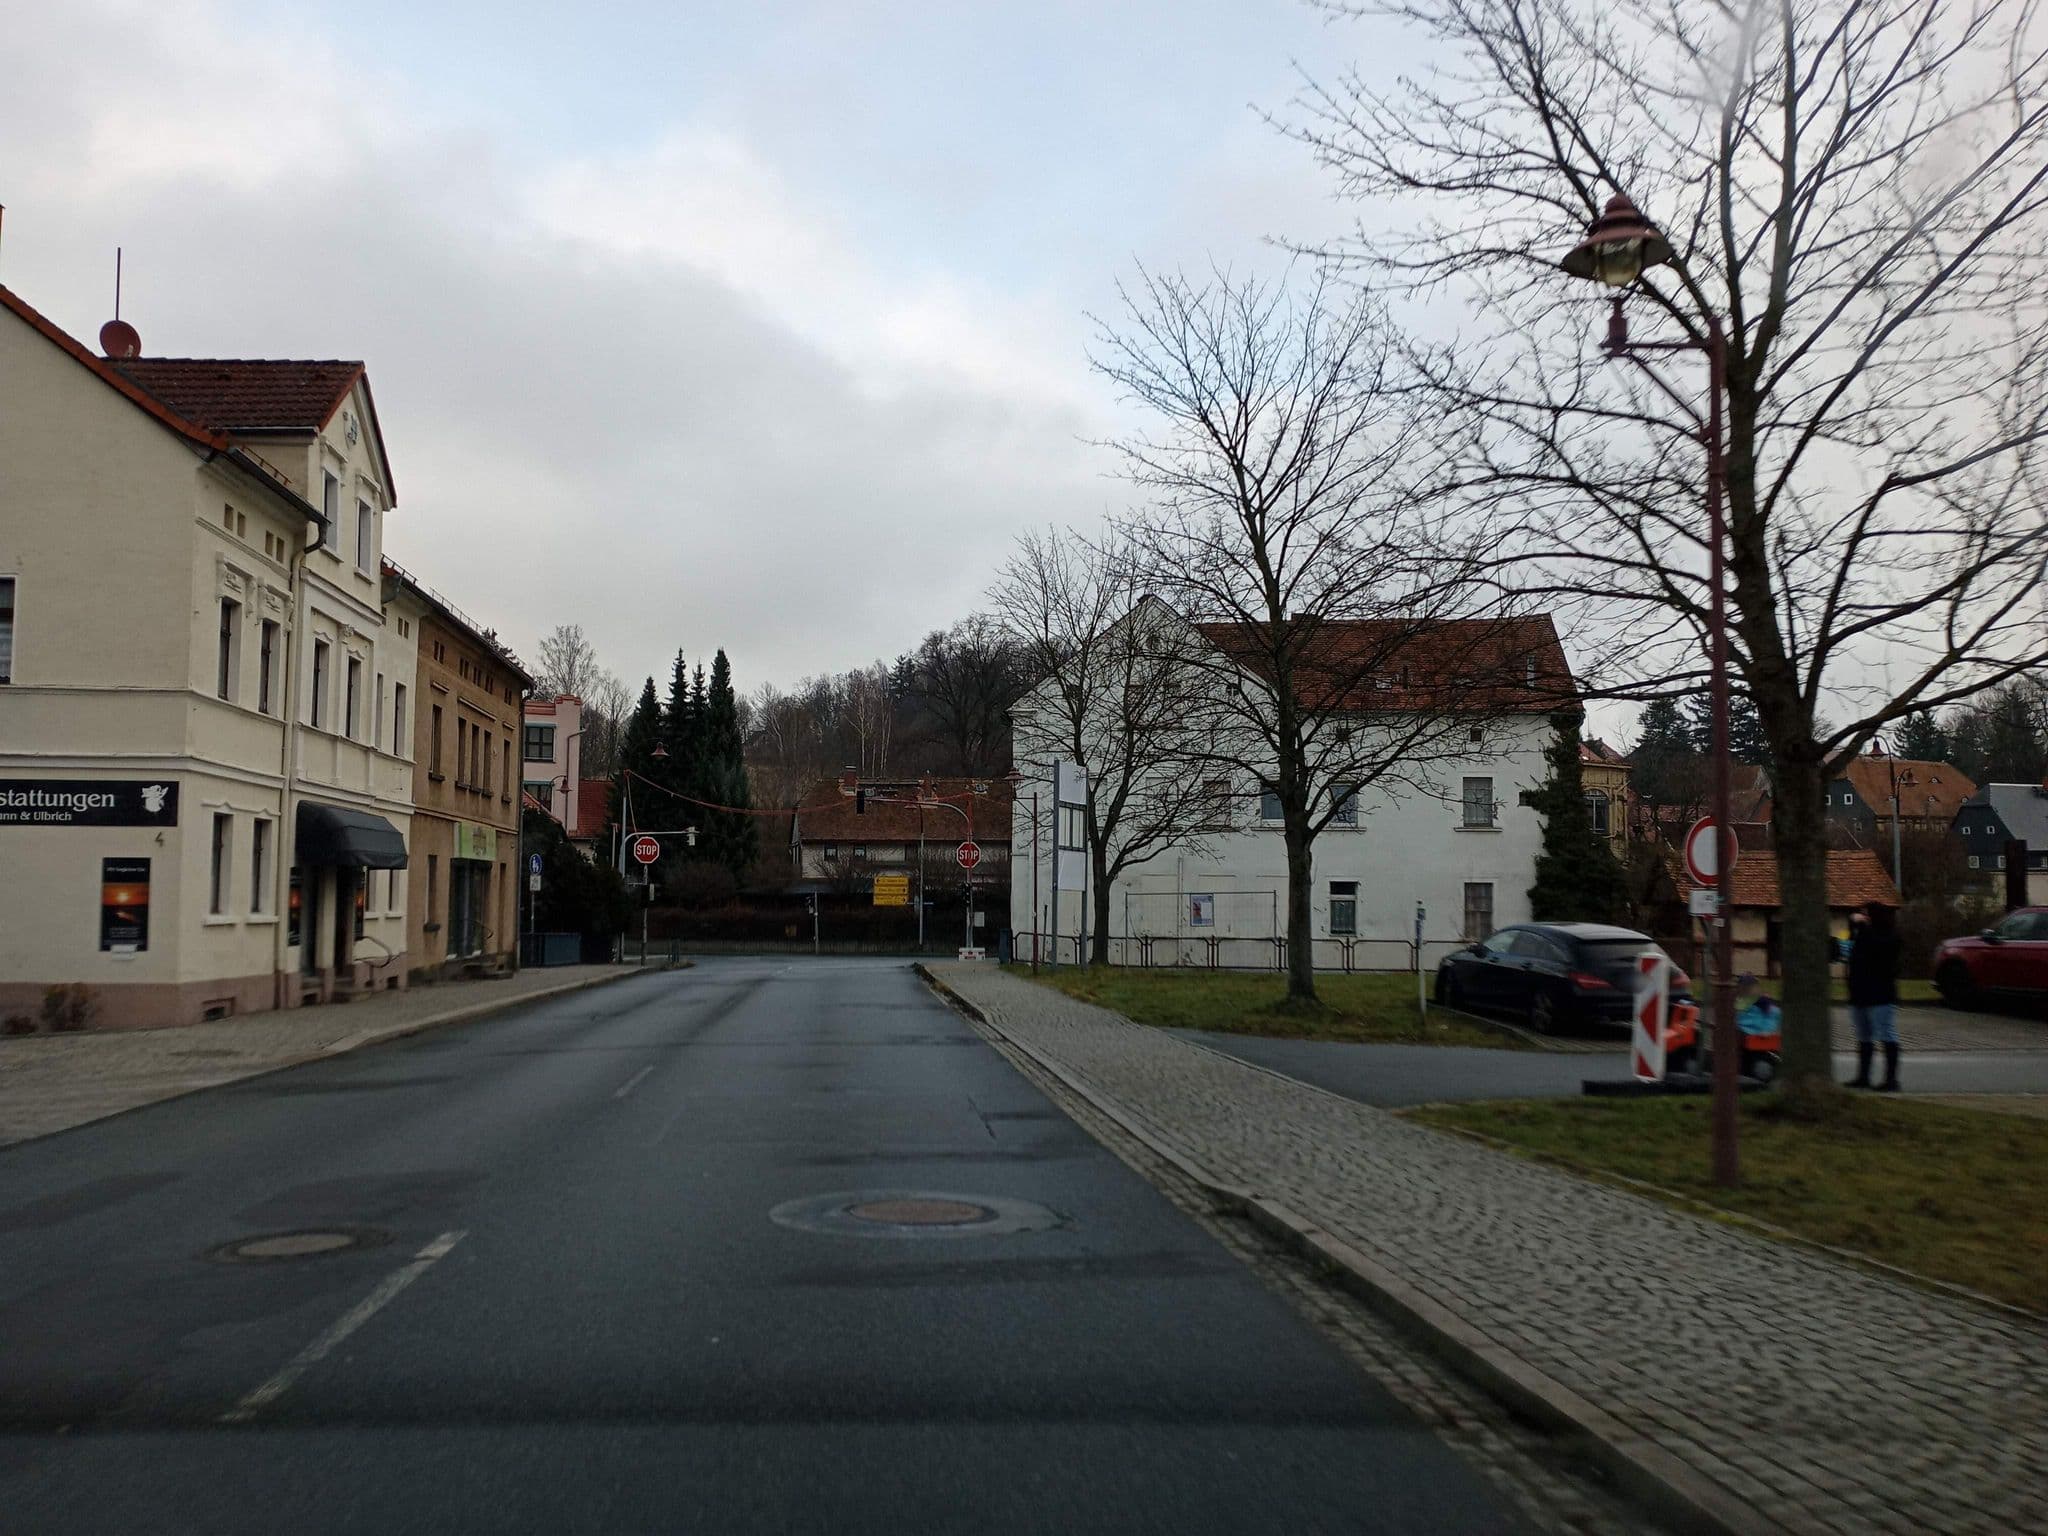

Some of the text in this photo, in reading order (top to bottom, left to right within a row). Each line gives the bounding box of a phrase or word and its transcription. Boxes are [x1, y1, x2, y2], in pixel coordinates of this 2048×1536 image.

[0, 789, 115, 811] stattungen
[20, 811, 31, 821] &
[33, 811, 73, 821] Ulbrich
[155, 831, 164, 848] 4
[637, 845, 657, 855] STOP
[960, 850, 979, 860] STOP
